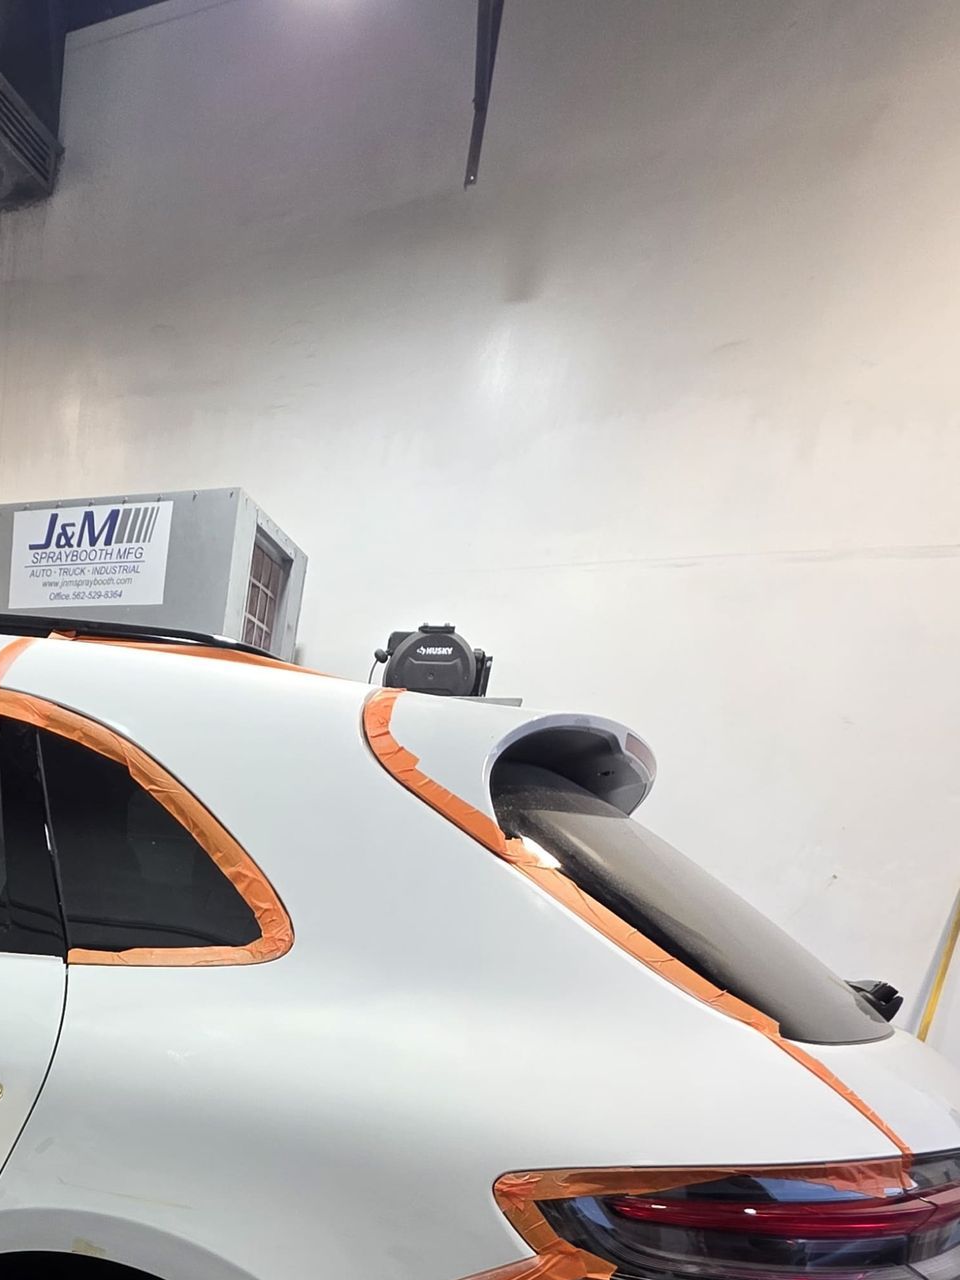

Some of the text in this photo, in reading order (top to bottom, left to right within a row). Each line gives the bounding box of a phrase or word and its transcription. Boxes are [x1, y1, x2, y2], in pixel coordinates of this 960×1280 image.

[29, 509, 120, 550] J&M
[31, 547, 144, 564] SPRAYBOOTH MFG
[29, 564, 141, 578] AUTO TRUCK INDUSTRIAL
[426, 647, 453, 655] HUSKY
